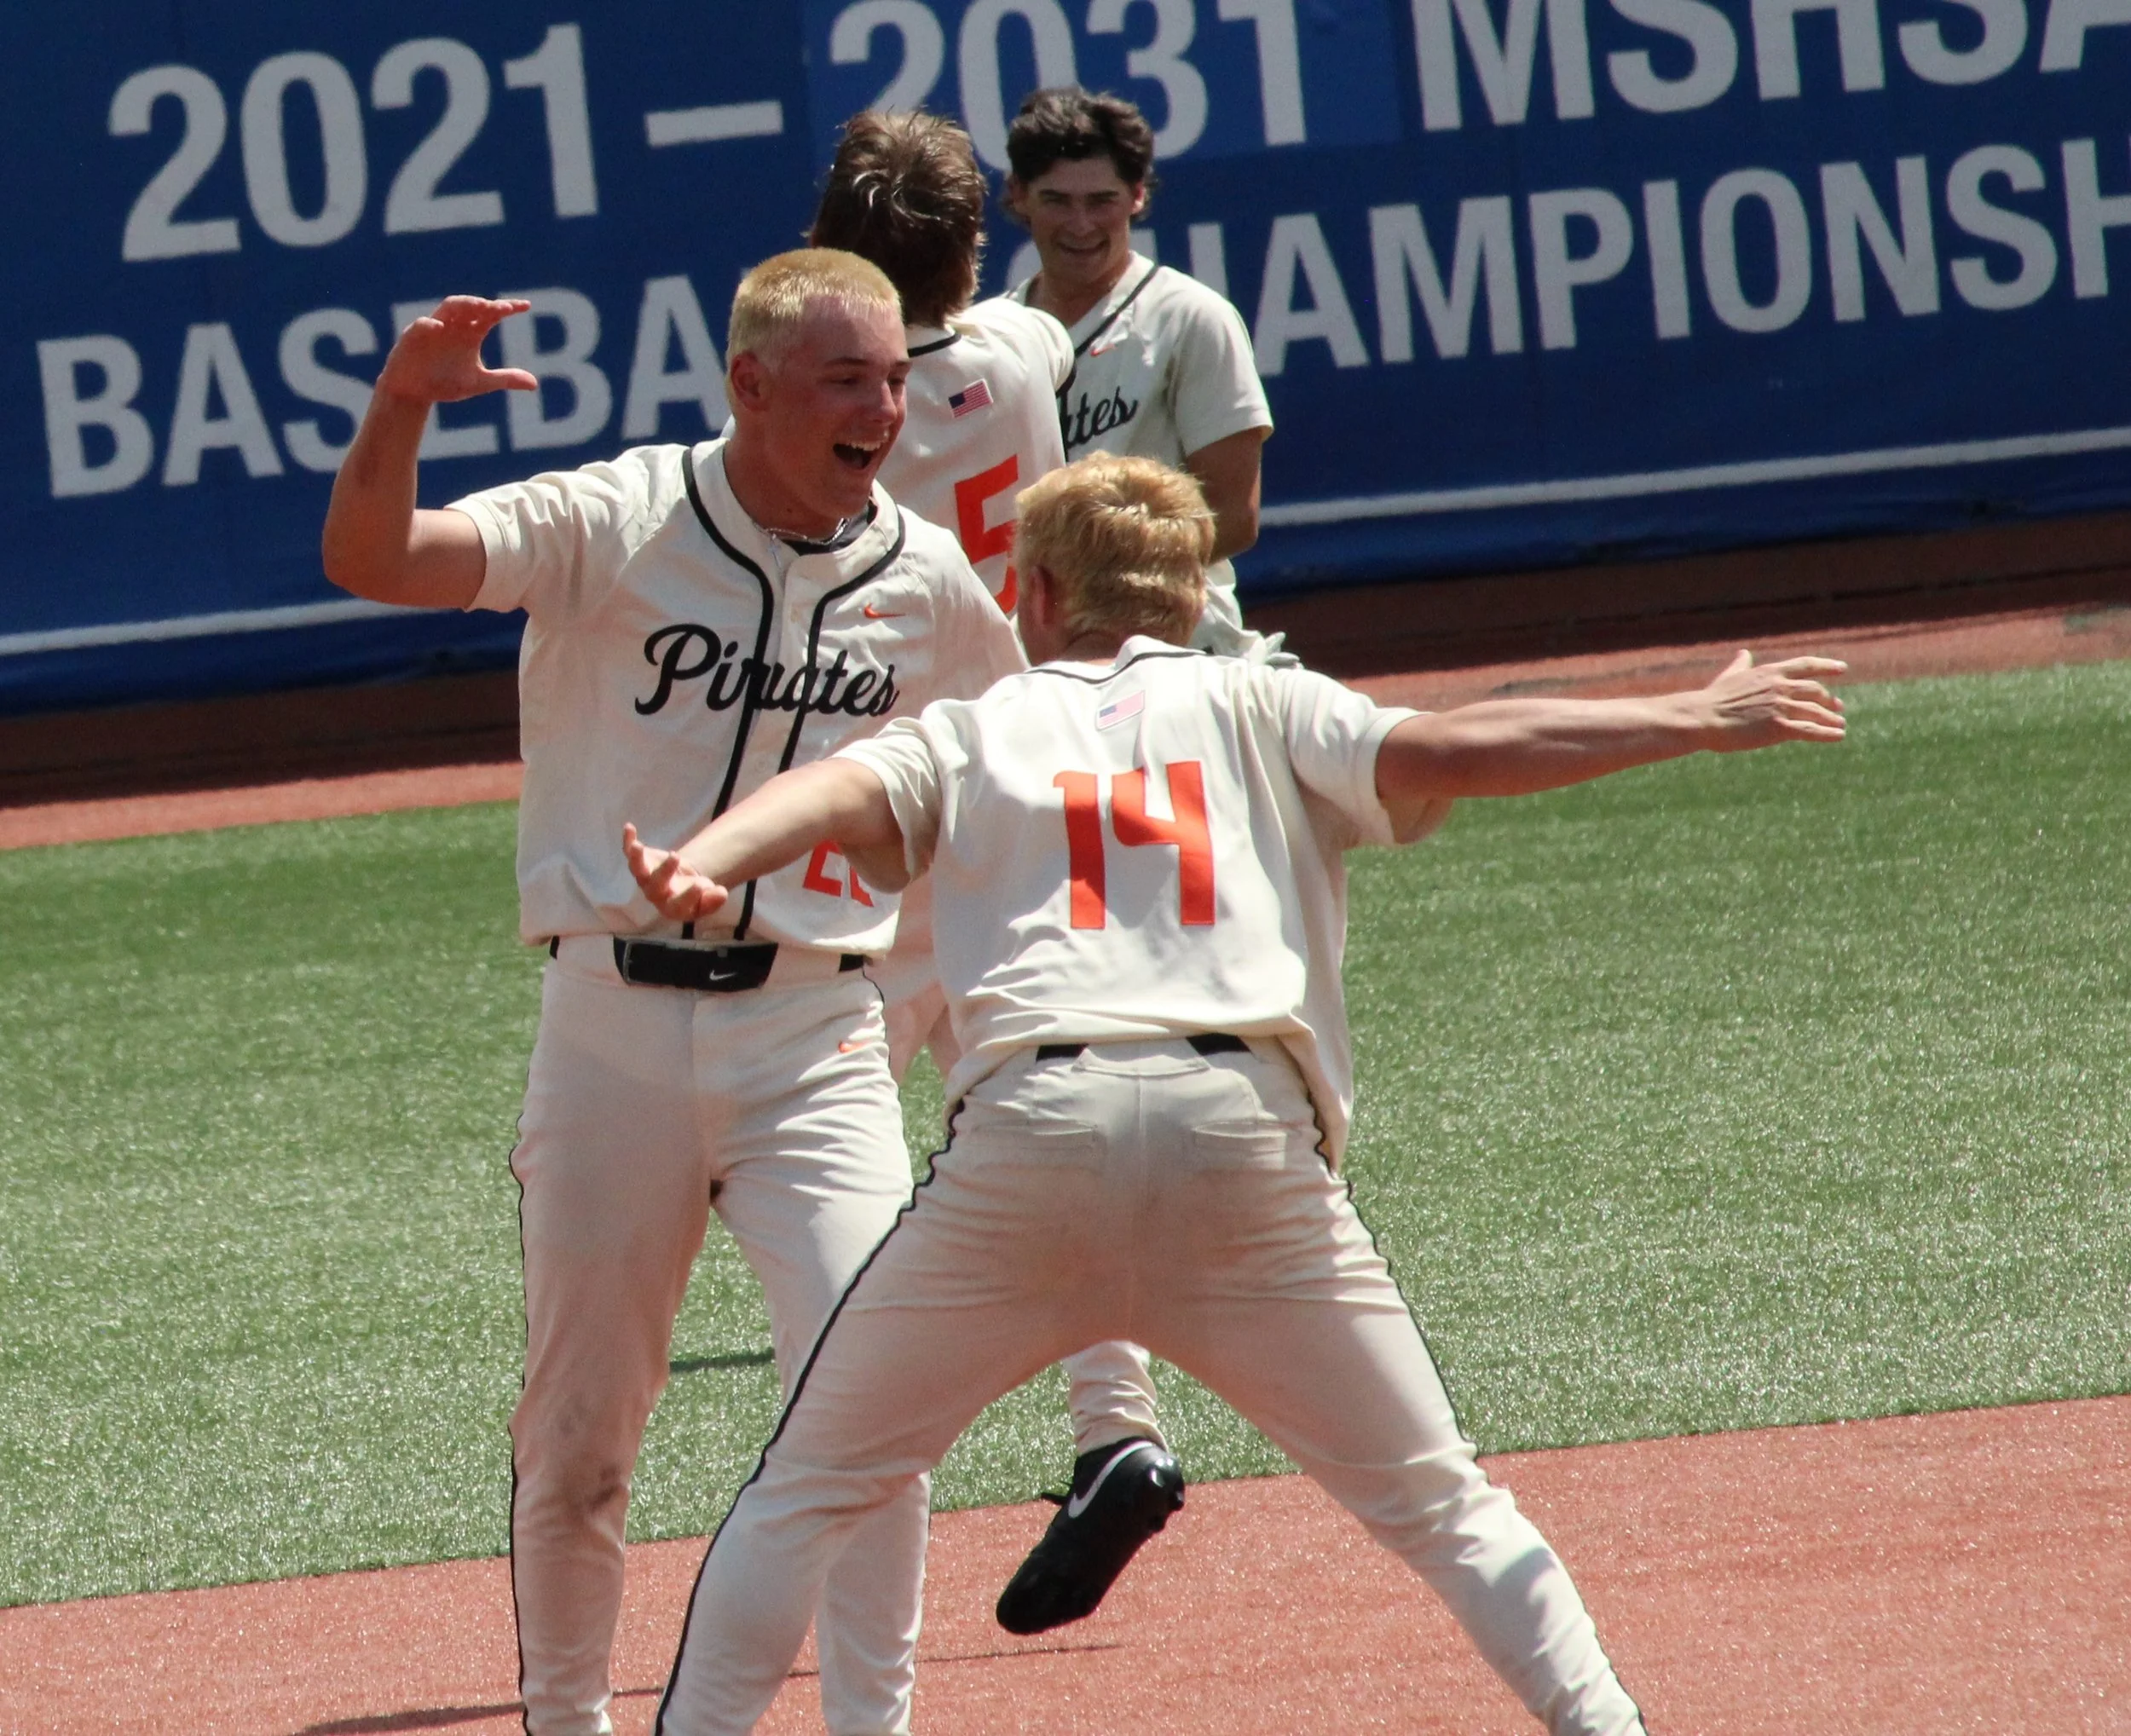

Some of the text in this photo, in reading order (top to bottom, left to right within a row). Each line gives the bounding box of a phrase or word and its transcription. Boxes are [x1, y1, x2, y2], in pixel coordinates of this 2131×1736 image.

[108, 22, 599, 262] 2021
[829, 0, 1307, 172] 2031
[36, 136, 2131, 499] BASBA AMPIONSH
[954, 453, 1019, 614] 5
[634, 623, 900, 717] Pirates
[1053, 760, 1215, 930] 14
